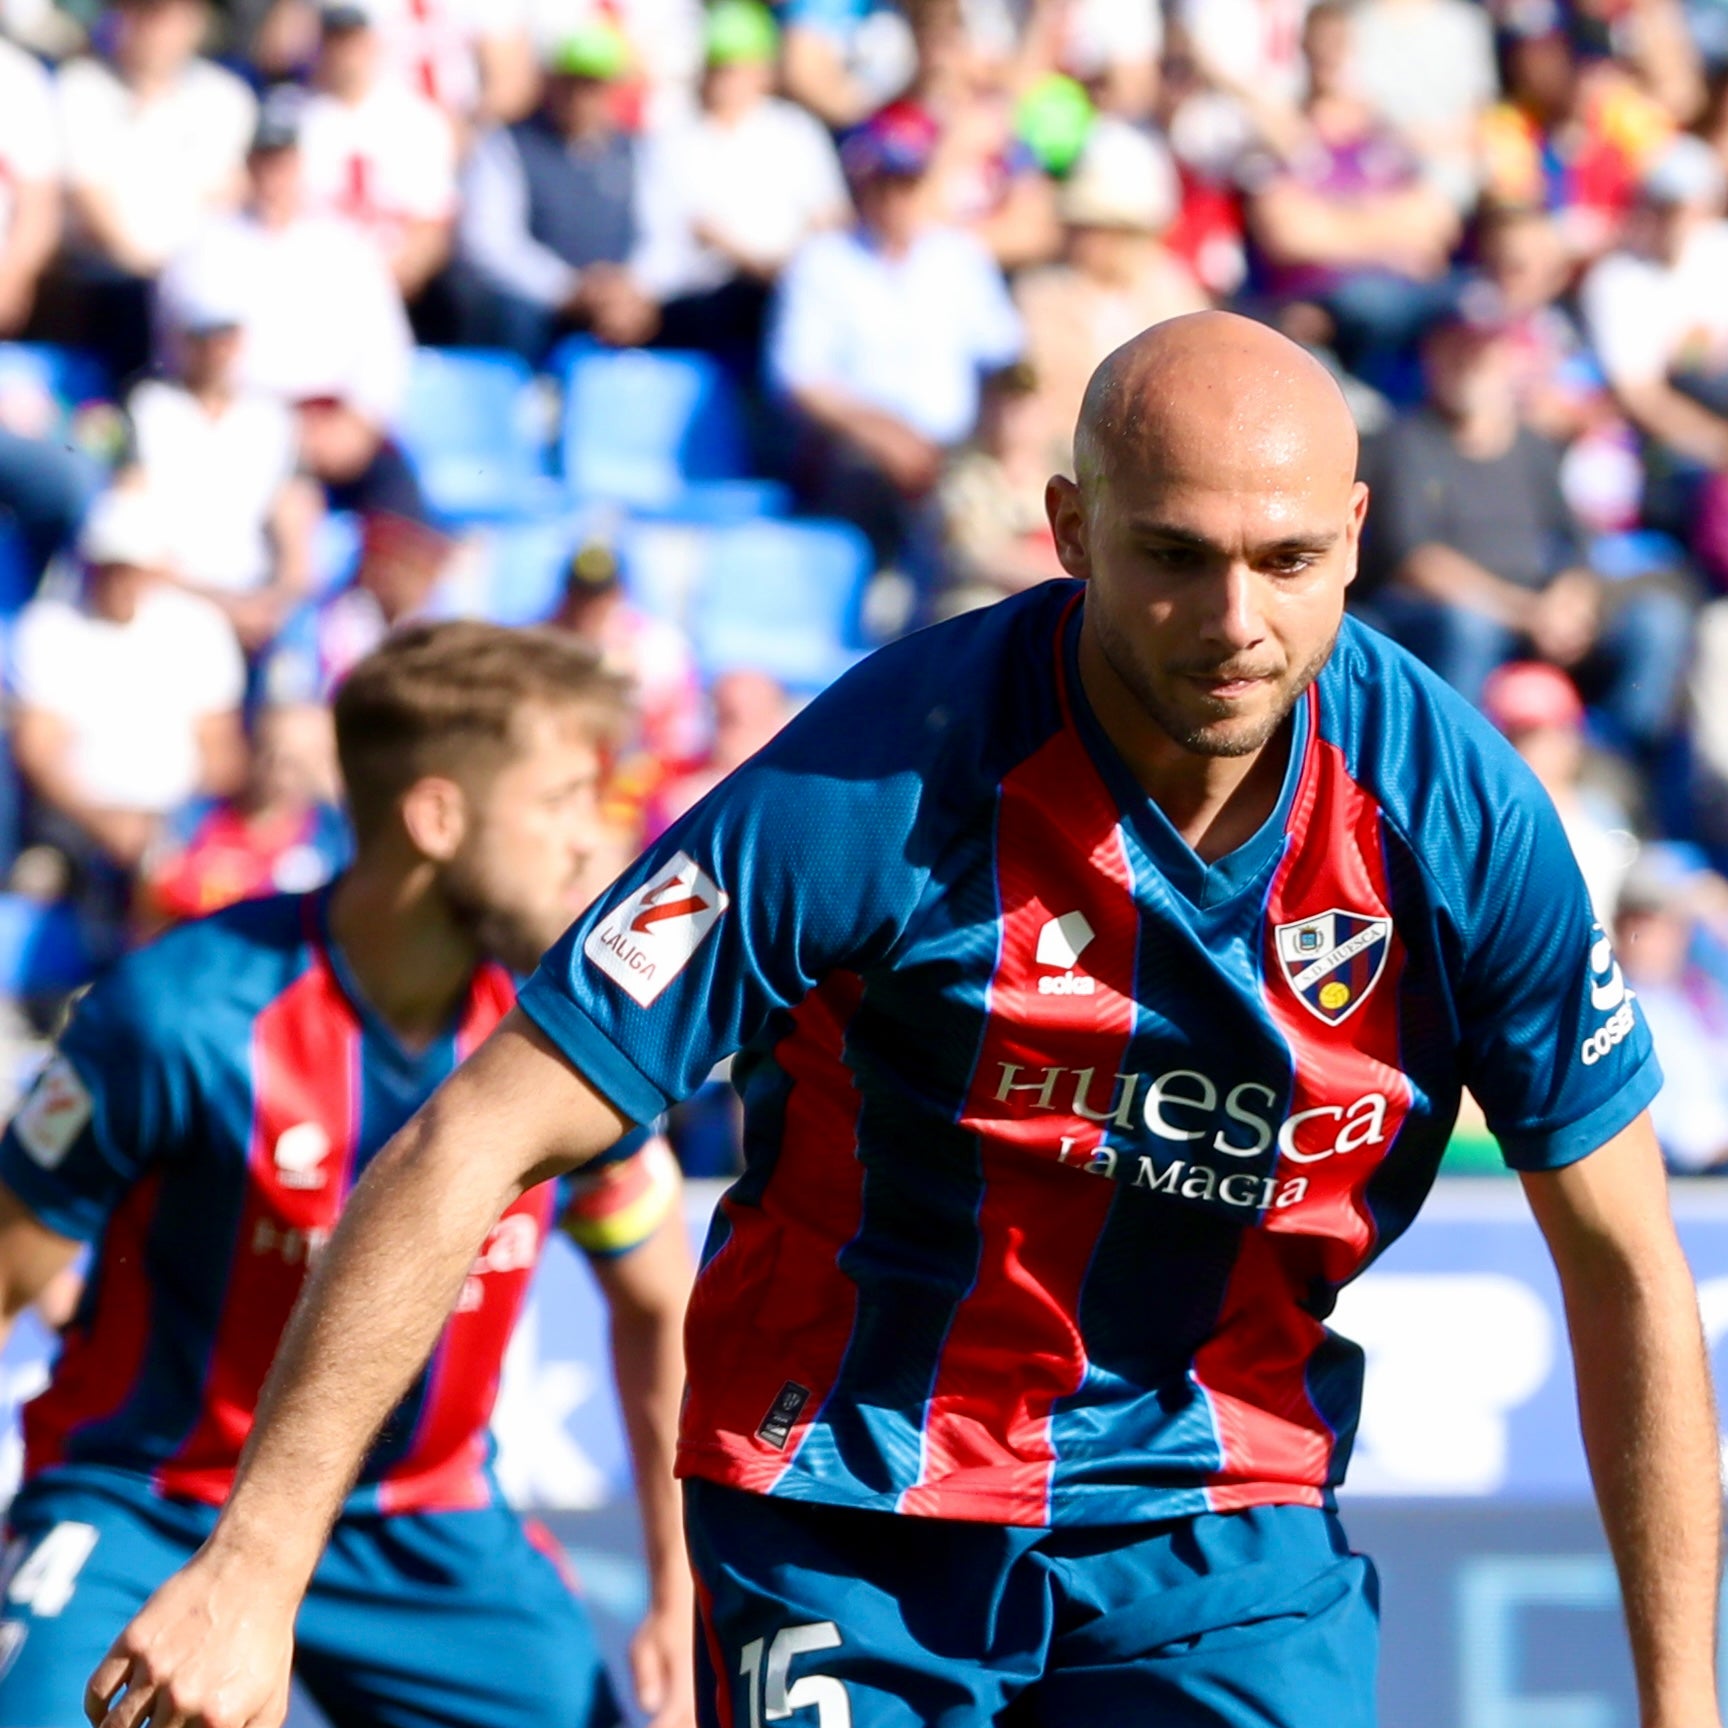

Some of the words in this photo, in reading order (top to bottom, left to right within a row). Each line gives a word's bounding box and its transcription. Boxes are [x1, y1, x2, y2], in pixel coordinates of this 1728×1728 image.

[600, 925, 656, 981] LALIGA
[1328, 927, 1382, 969] HUESCA
[1038, 972, 1096, 996] soka
[1056, 1136, 1120, 1181] La
